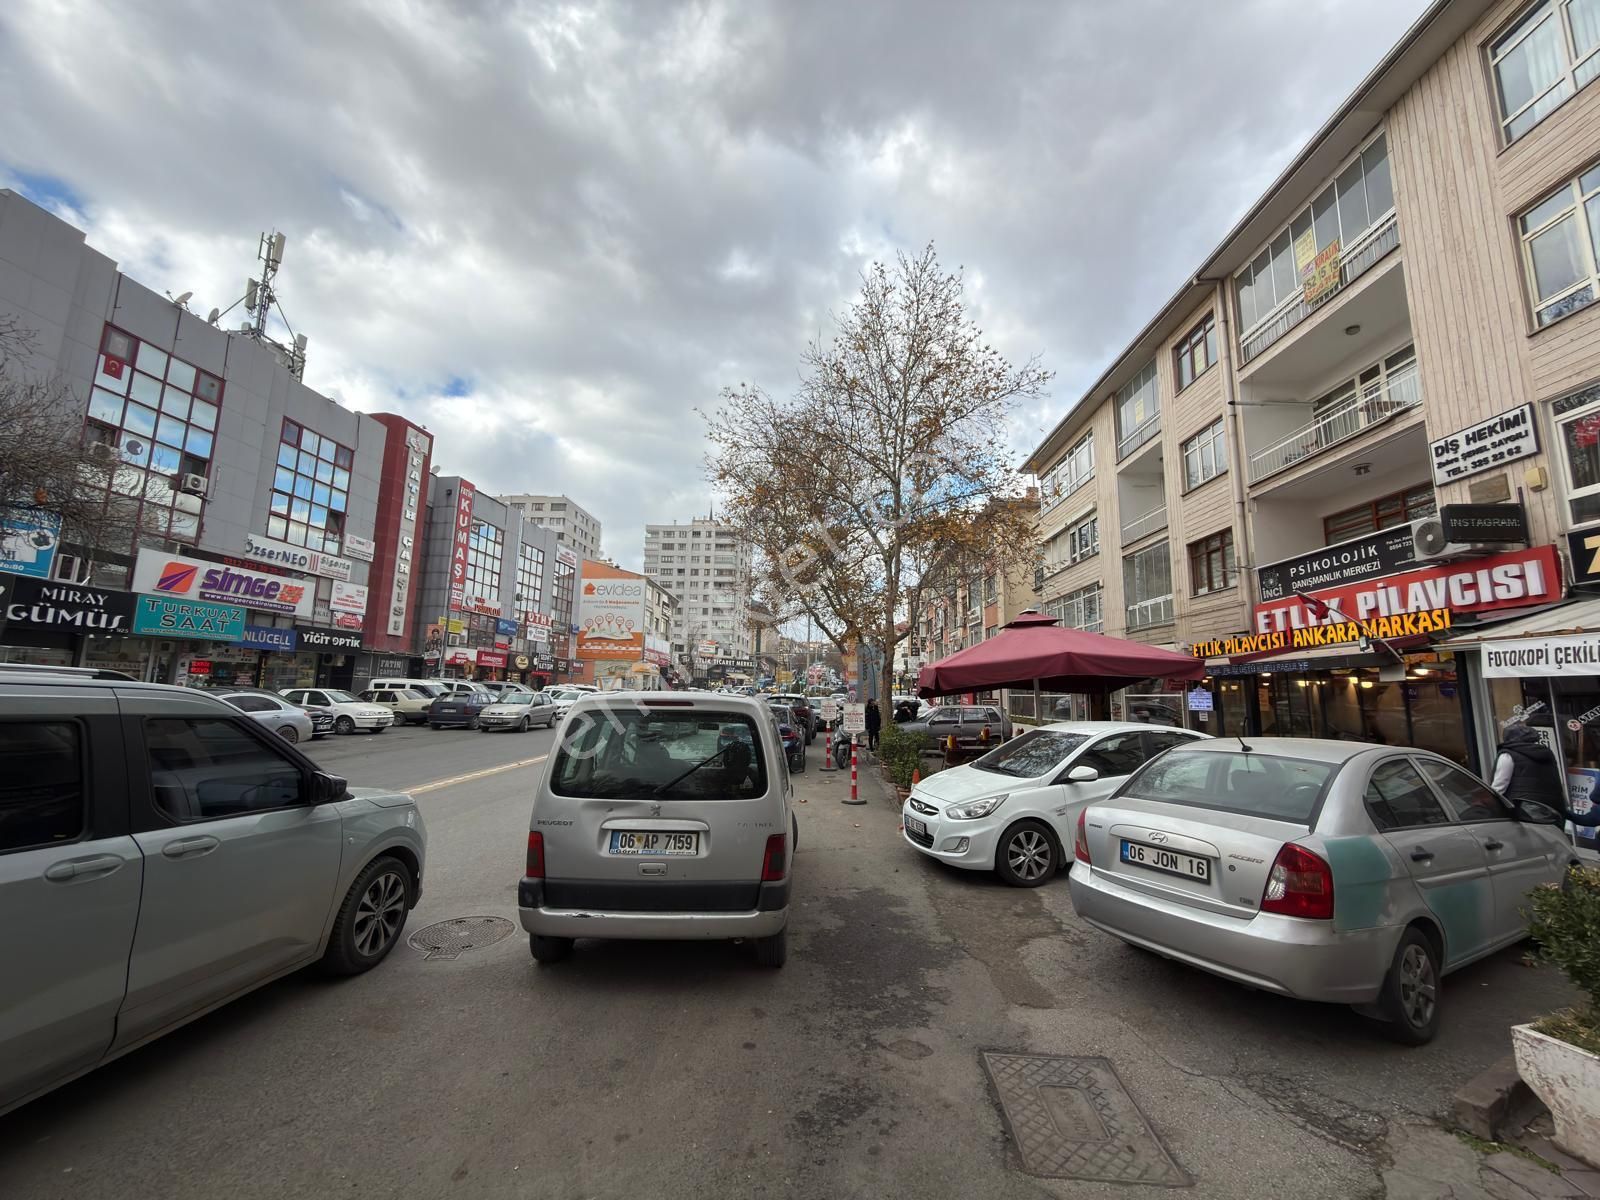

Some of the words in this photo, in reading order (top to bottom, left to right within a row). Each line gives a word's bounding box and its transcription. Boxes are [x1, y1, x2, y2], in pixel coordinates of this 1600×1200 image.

[1434, 439, 1460, 457] DİŞ
[1465, 408, 1527, 445] HEKİMİ
[1471, 456, 1490, 469] 325
[1491, 451, 1505, 462] 22
[453, 498, 470, 580] KUMAŞ
[1289, 544, 1378, 577] PSİKOLOJİK
[1291, 574, 1342, 590] DANIŞMANLIK
[1343, 558, 1381, 577] MERKEZİ
[41, 586, 109, 606] MİRAY
[596, 583, 641, 596] evidea
[1262, 583, 1283, 599] İNCİ
[1356, 560, 1543, 620] PİLAVCISI
[146, 599, 241, 622] TURKUAZ
[160, 614, 230, 632] SAAT
[1193, 638, 1223, 657] ETLİK
[1225, 632, 1286, 655] PİLAVCISI
[1293, 620, 1361, 648] ANKARA
[1362, 608, 1451, 640] MARKASI
[242, 630, 291, 646] NLÜCELL
[303, 631, 332, 645] YİĞİT
[332, 635, 361, 648] OPTİK
[1487, 644, 1549, 667] FOTOKOPİ
[619, 833, 635, 849] 06
[643, 834, 658, 850] AP
[664, 834, 693, 851] 7159
[1129, 845, 1145, 862] 06
[1152, 851, 1179, 870] JON
[1188, 859, 1205, 876] 16
